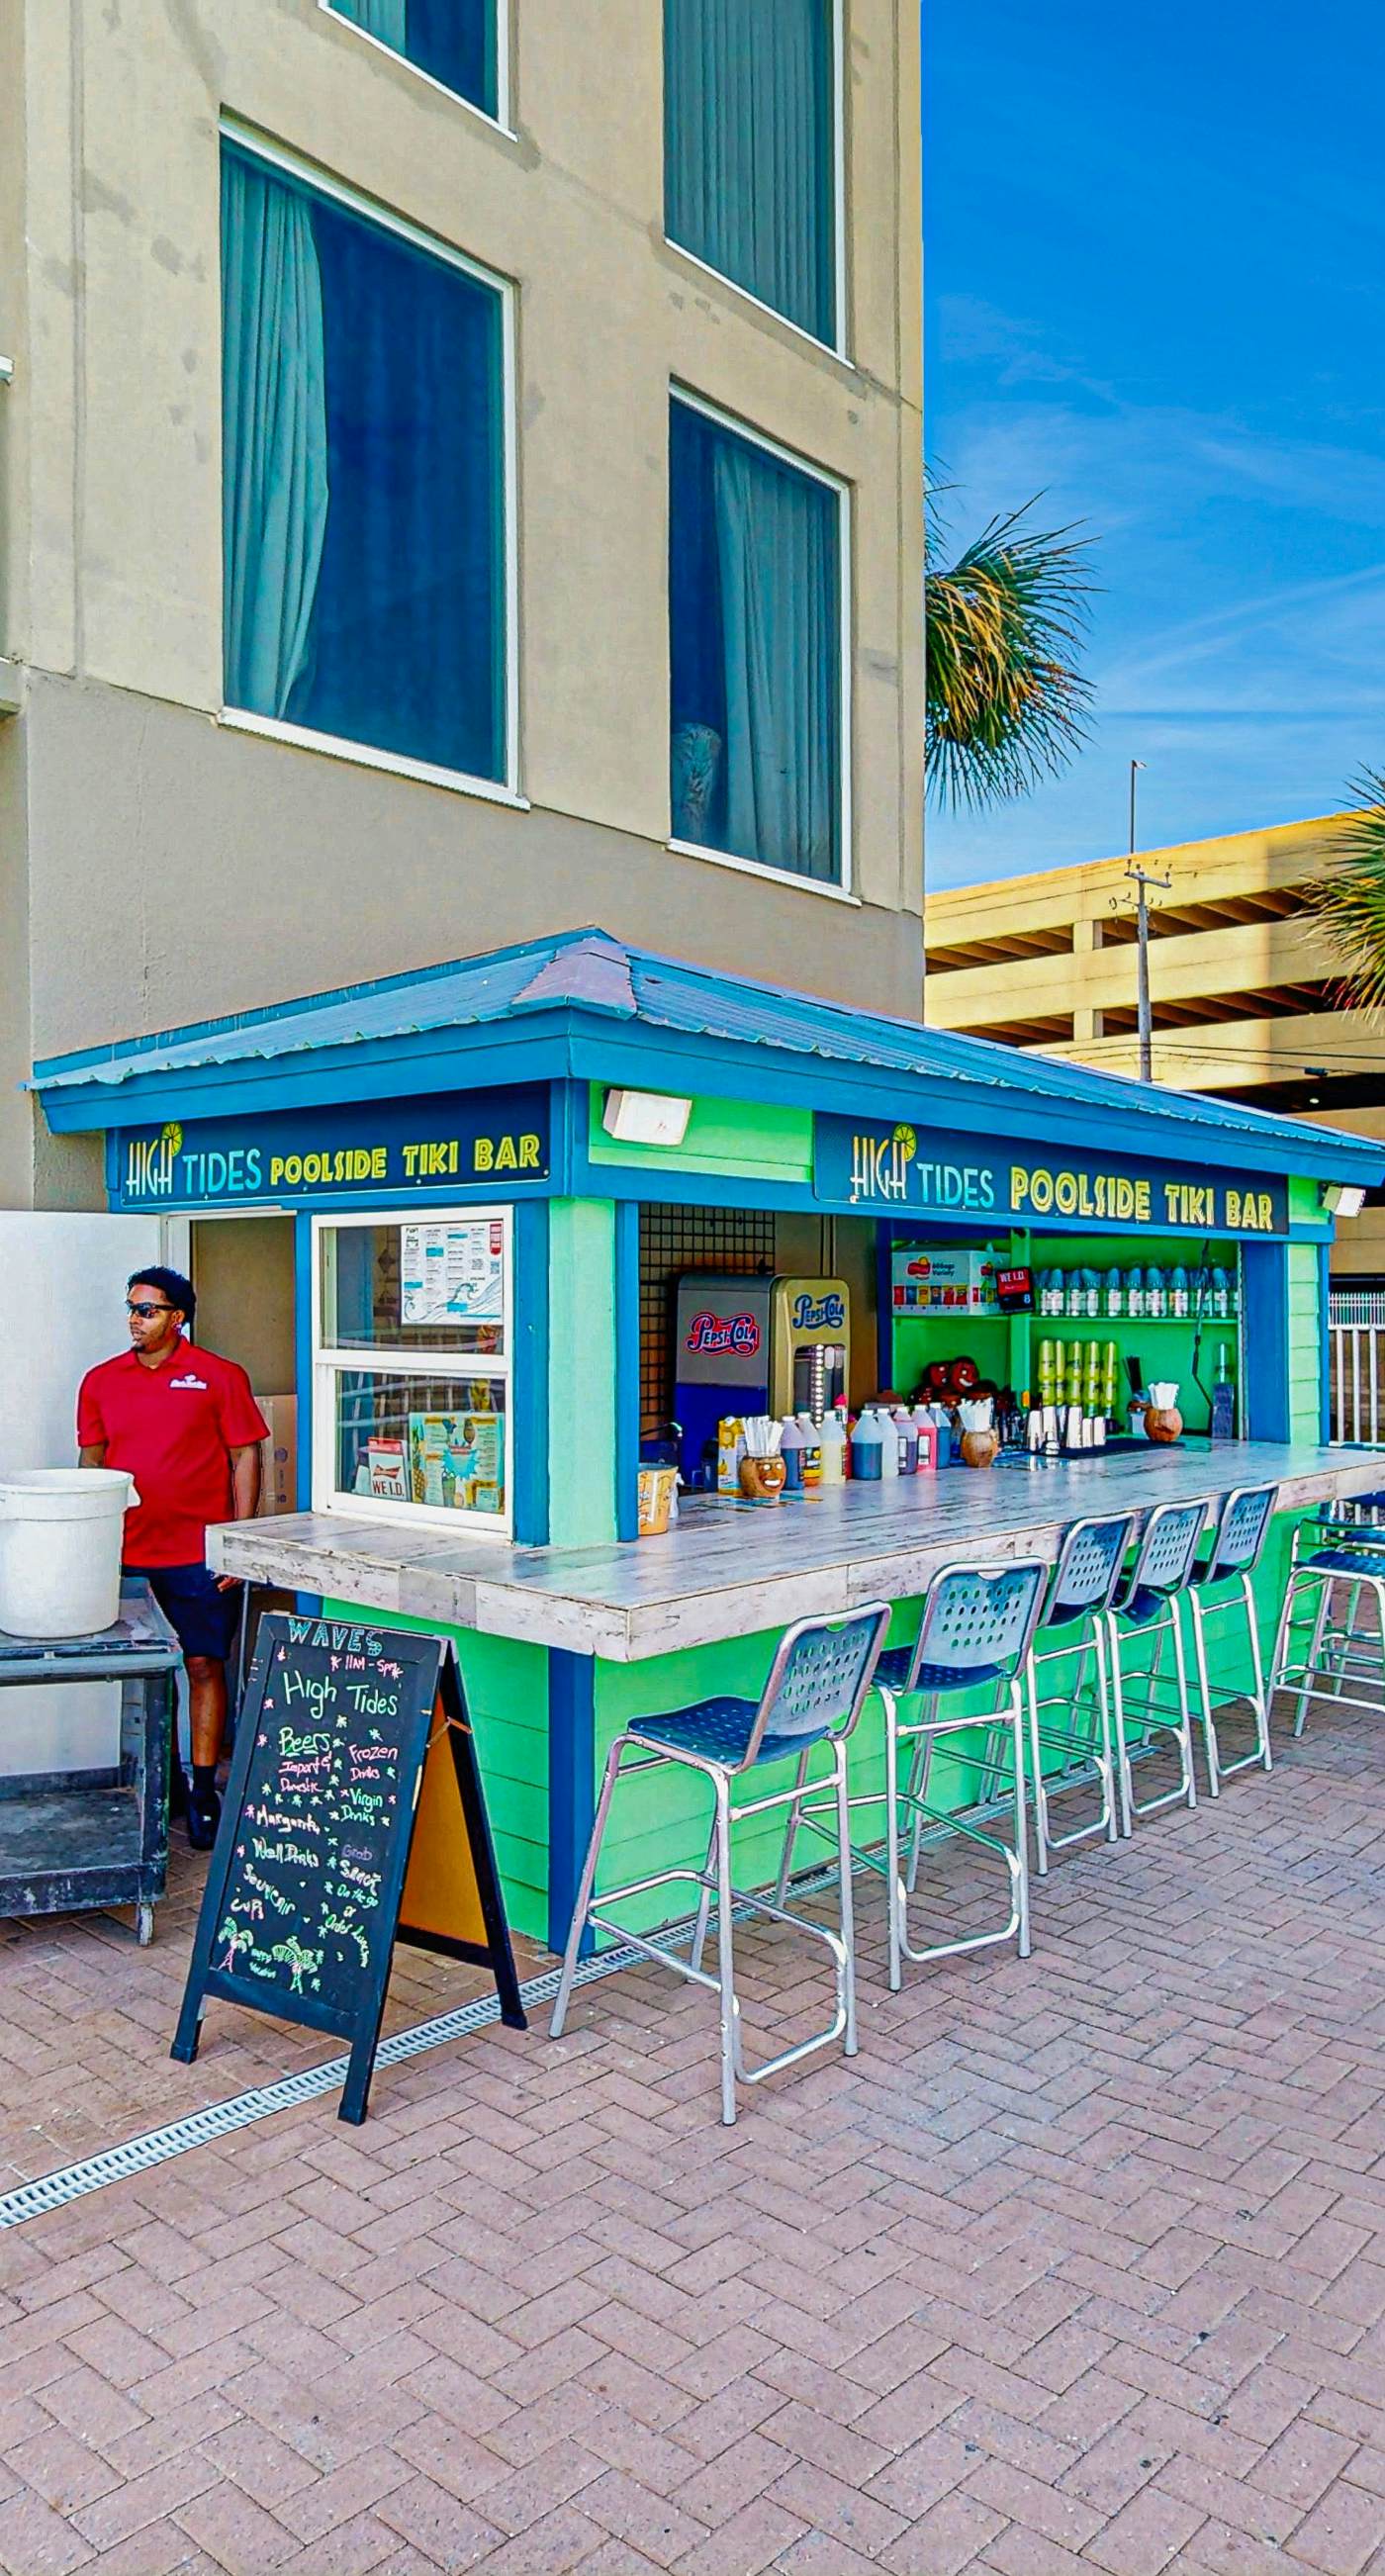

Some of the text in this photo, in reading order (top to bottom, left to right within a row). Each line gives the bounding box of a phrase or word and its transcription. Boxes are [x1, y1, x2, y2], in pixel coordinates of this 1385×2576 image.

[126, 1135, 540, 1196] HIGH TIDES POOLSIDE TIKI BAR
[850, 1136, 1273, 1231] HIGH TIDES POOLSIDE TIKI BAR
[372, 1480, 387, 1495] WE
[287, 1617, 384, 1657] WAVES
[283, 1670, 398, 1719] High Tides
[278, 1726, 330, 1757] Beers
[348, 1744, 398, 1764] Frozen
[349, 1788, 383, 1813] Virgin
[251, 1836, 284, 1864] Well
[341, 1844, 373, 1861] Grab
